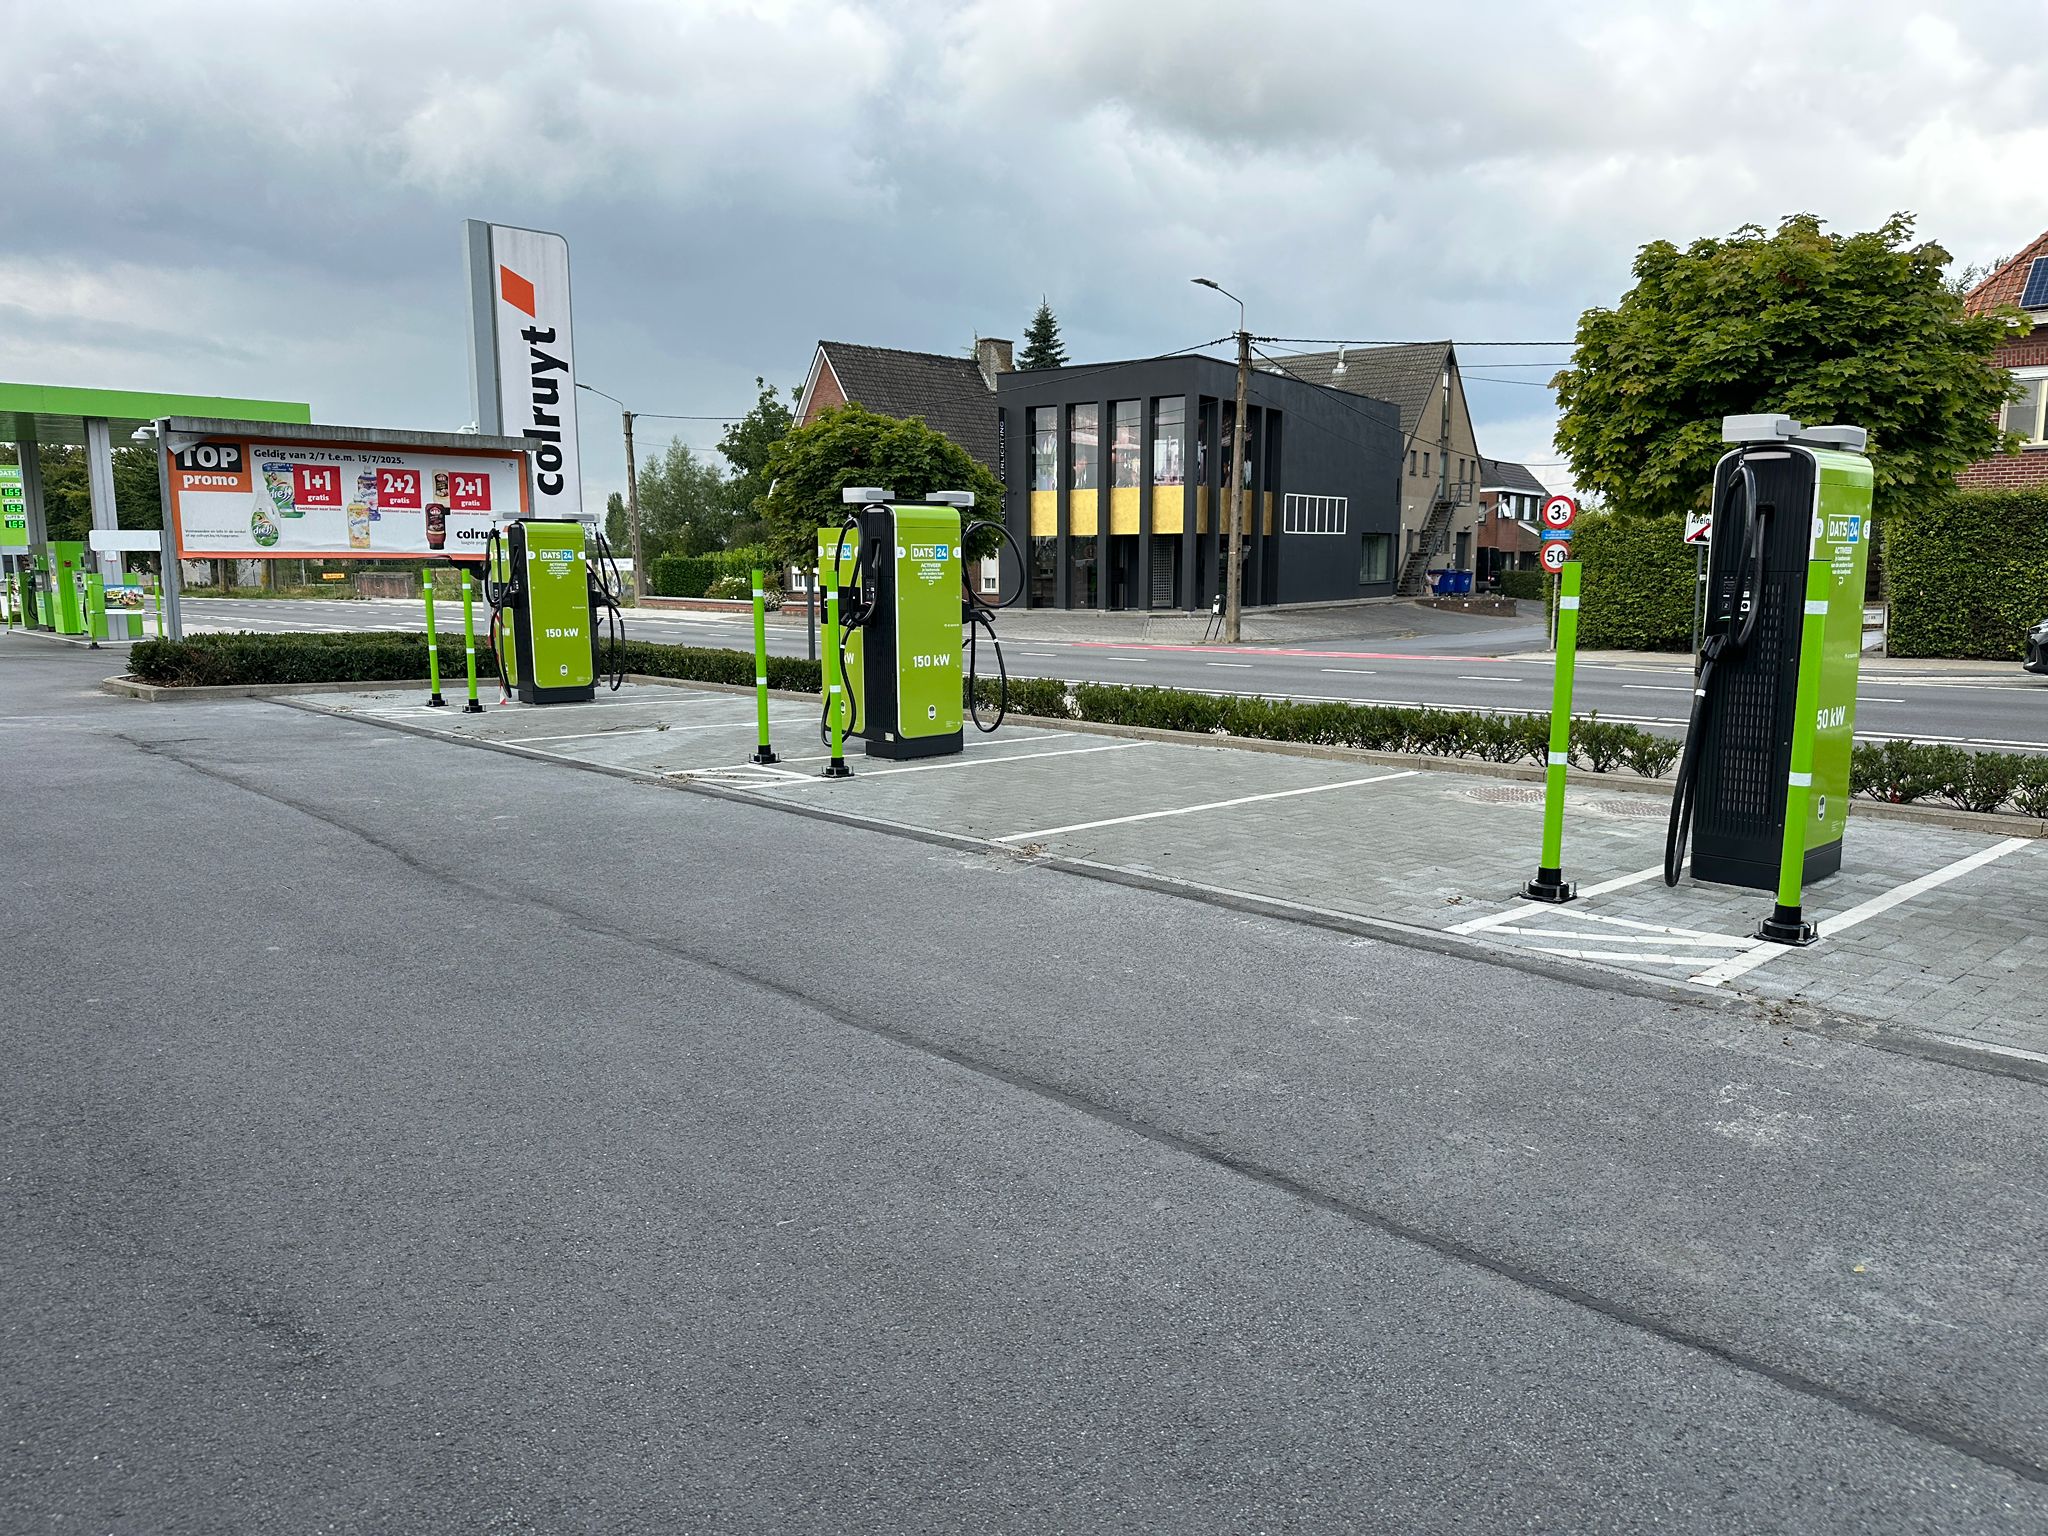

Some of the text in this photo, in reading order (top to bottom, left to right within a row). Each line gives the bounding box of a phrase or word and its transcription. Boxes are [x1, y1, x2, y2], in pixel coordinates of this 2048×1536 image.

[520, 325, 569, 496] colruyt
[183, 445, 239, 468] TOP
[253, 449, 286, 460] Geldig
[309, 451, 326, 461] 2/7
[328, 453, 355, 462] t.e.m.
[357, 454, 405, 465] 15/7/2025.
[182, 474, 239, 489] promo
[302, 469, 332, 491] 1+1
[383, 473, 416, 494] 2+2
[455, 476, 483, 497] 2+1
[307, 493, 330, 502] gratis
[389, 497, 410, 505] gratis
[461, 499, 481, 507] gratis
[1691, 516, 1712, 526] Avelg
[456, 528, 501, 540] colru
[1829, 521, 1858, 538] DATS 24
[542, 550, 572, 559] DATS 24
[913, 547, 947, 558] DATS 24
[1546, 550, 1565, 563] 50
[545, 627, 579, 638] 150 kW
[912, 653, 951, 668] 150 kW
[1816, 705, 1846, 730] 50 kW
